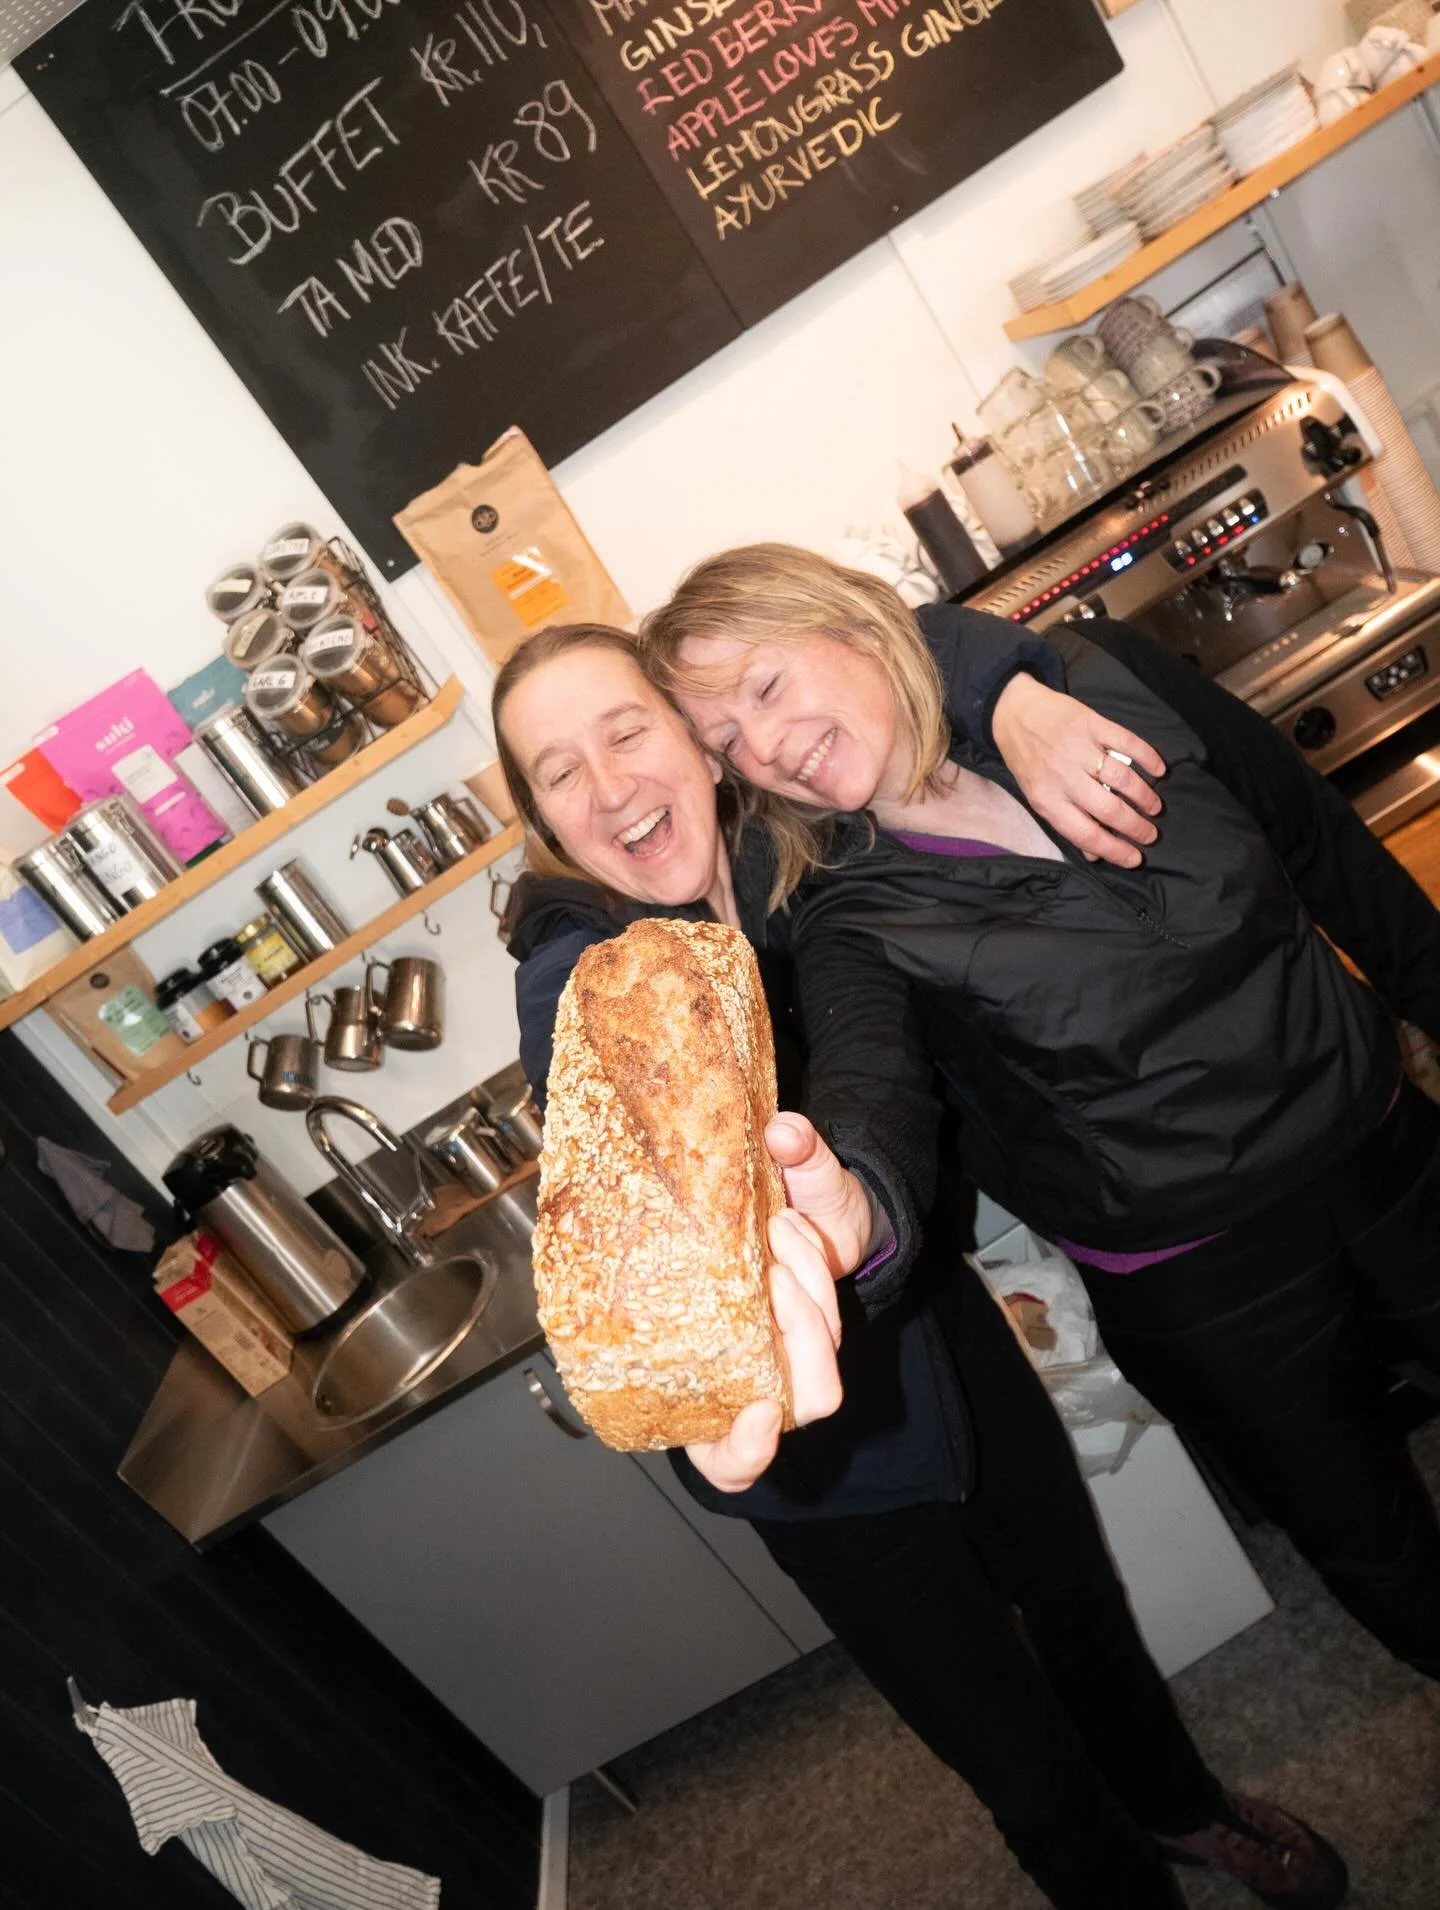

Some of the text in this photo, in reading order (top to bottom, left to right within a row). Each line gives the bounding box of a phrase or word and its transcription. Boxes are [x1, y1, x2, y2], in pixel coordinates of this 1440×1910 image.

[667, 74, 768, 161] APPLE
[756, 15, 859, 94] LOVES
[708, 0, 822, 69] BERR
[197, 77, 401, 265] BUFFET
[686, 41, 895, 199] LEMONGRASS
[714, 96, 903, 240] AYURVEDIC
[278, 79, 598, 337] TA MED KR 89
[432, 201, 605, 356] KAFFE/TE
